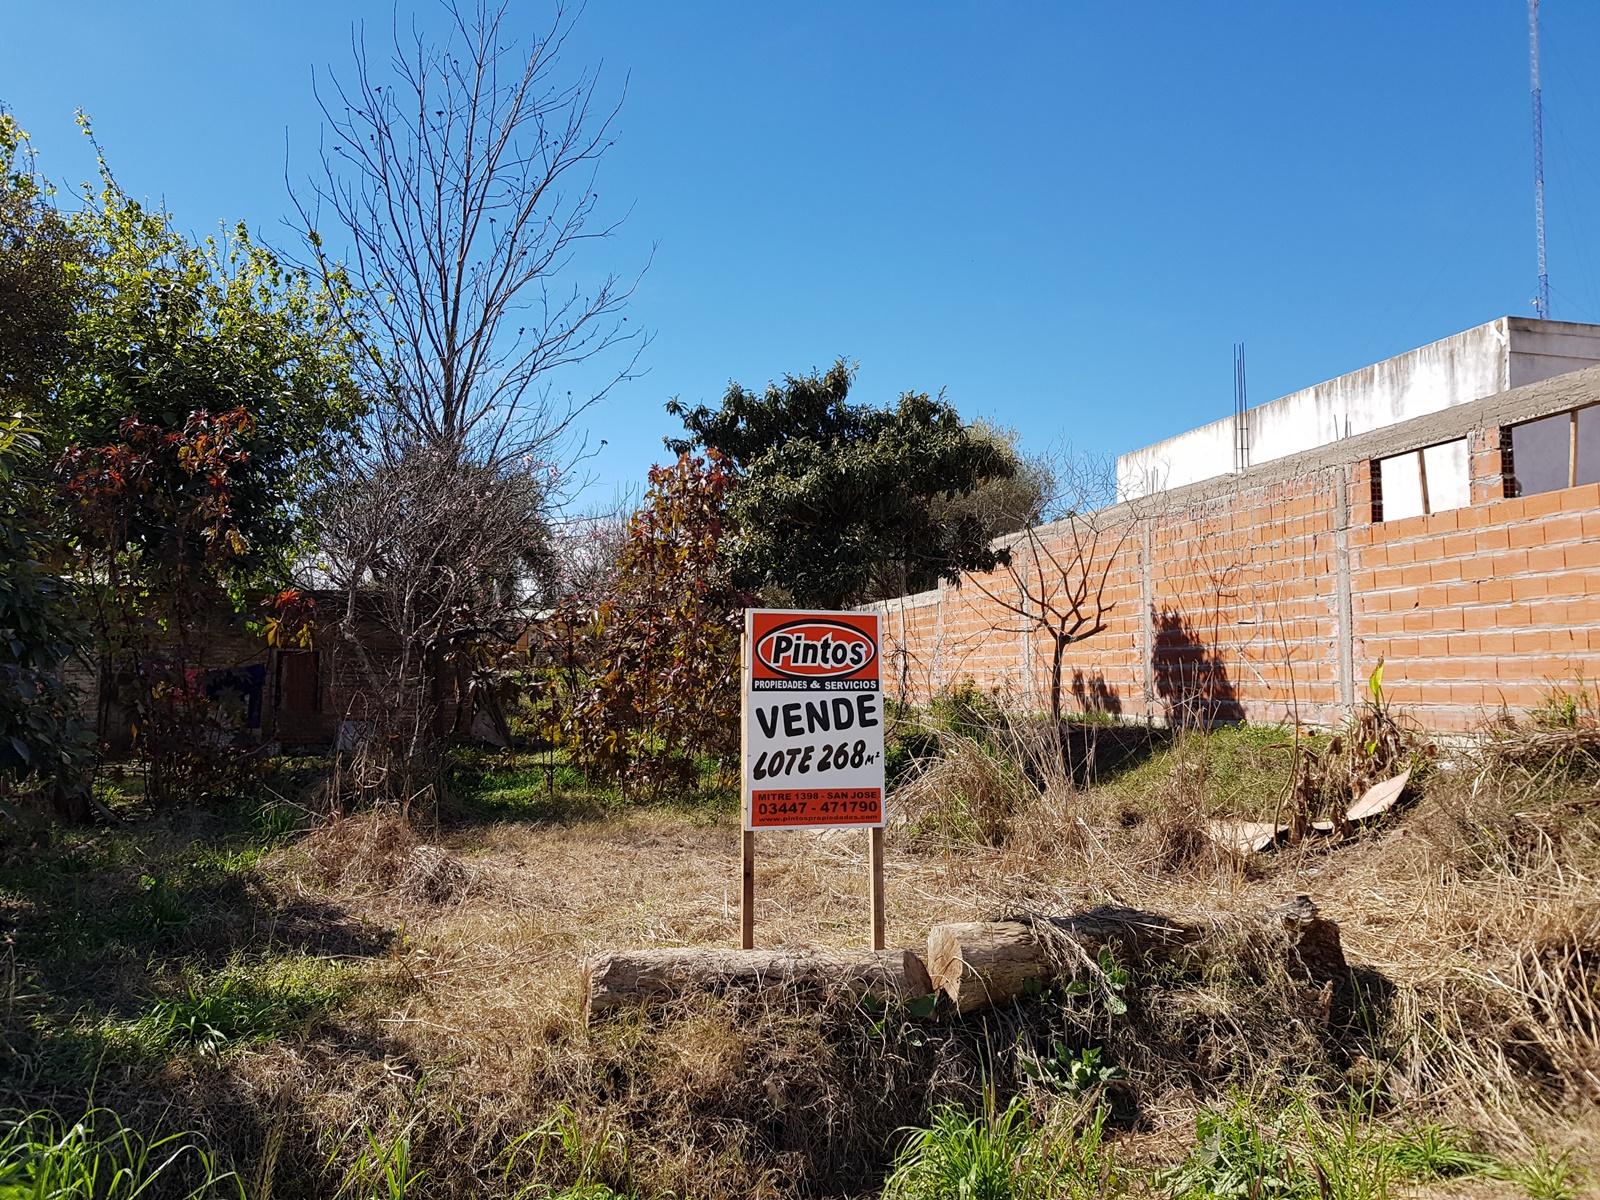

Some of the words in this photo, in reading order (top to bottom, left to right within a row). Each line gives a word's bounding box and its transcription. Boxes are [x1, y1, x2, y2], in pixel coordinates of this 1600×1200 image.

[772, 633, 866, 667] Pintos
[754, 680, 808, 690] PROPIEDADES
[809, 680, 822, 689] &
[824, 680, 877, 690] SERVICIOS
[755, 693, 879, 739] VENDE
[752, 745, 815, 781] LOTE
[816, 739, 867, 773] 268
[758, 793, 793, 801] MITRE
[795, 792, 819, 800] 1398
[826, 792, 849, 800] SAN
[850, 791, 877, 799] JOSE
[758, 802, 808, 815] 03447
[820, 801, 878, 813] 471790
[758, 814, 878, 823] www.pintospropiedades.com
